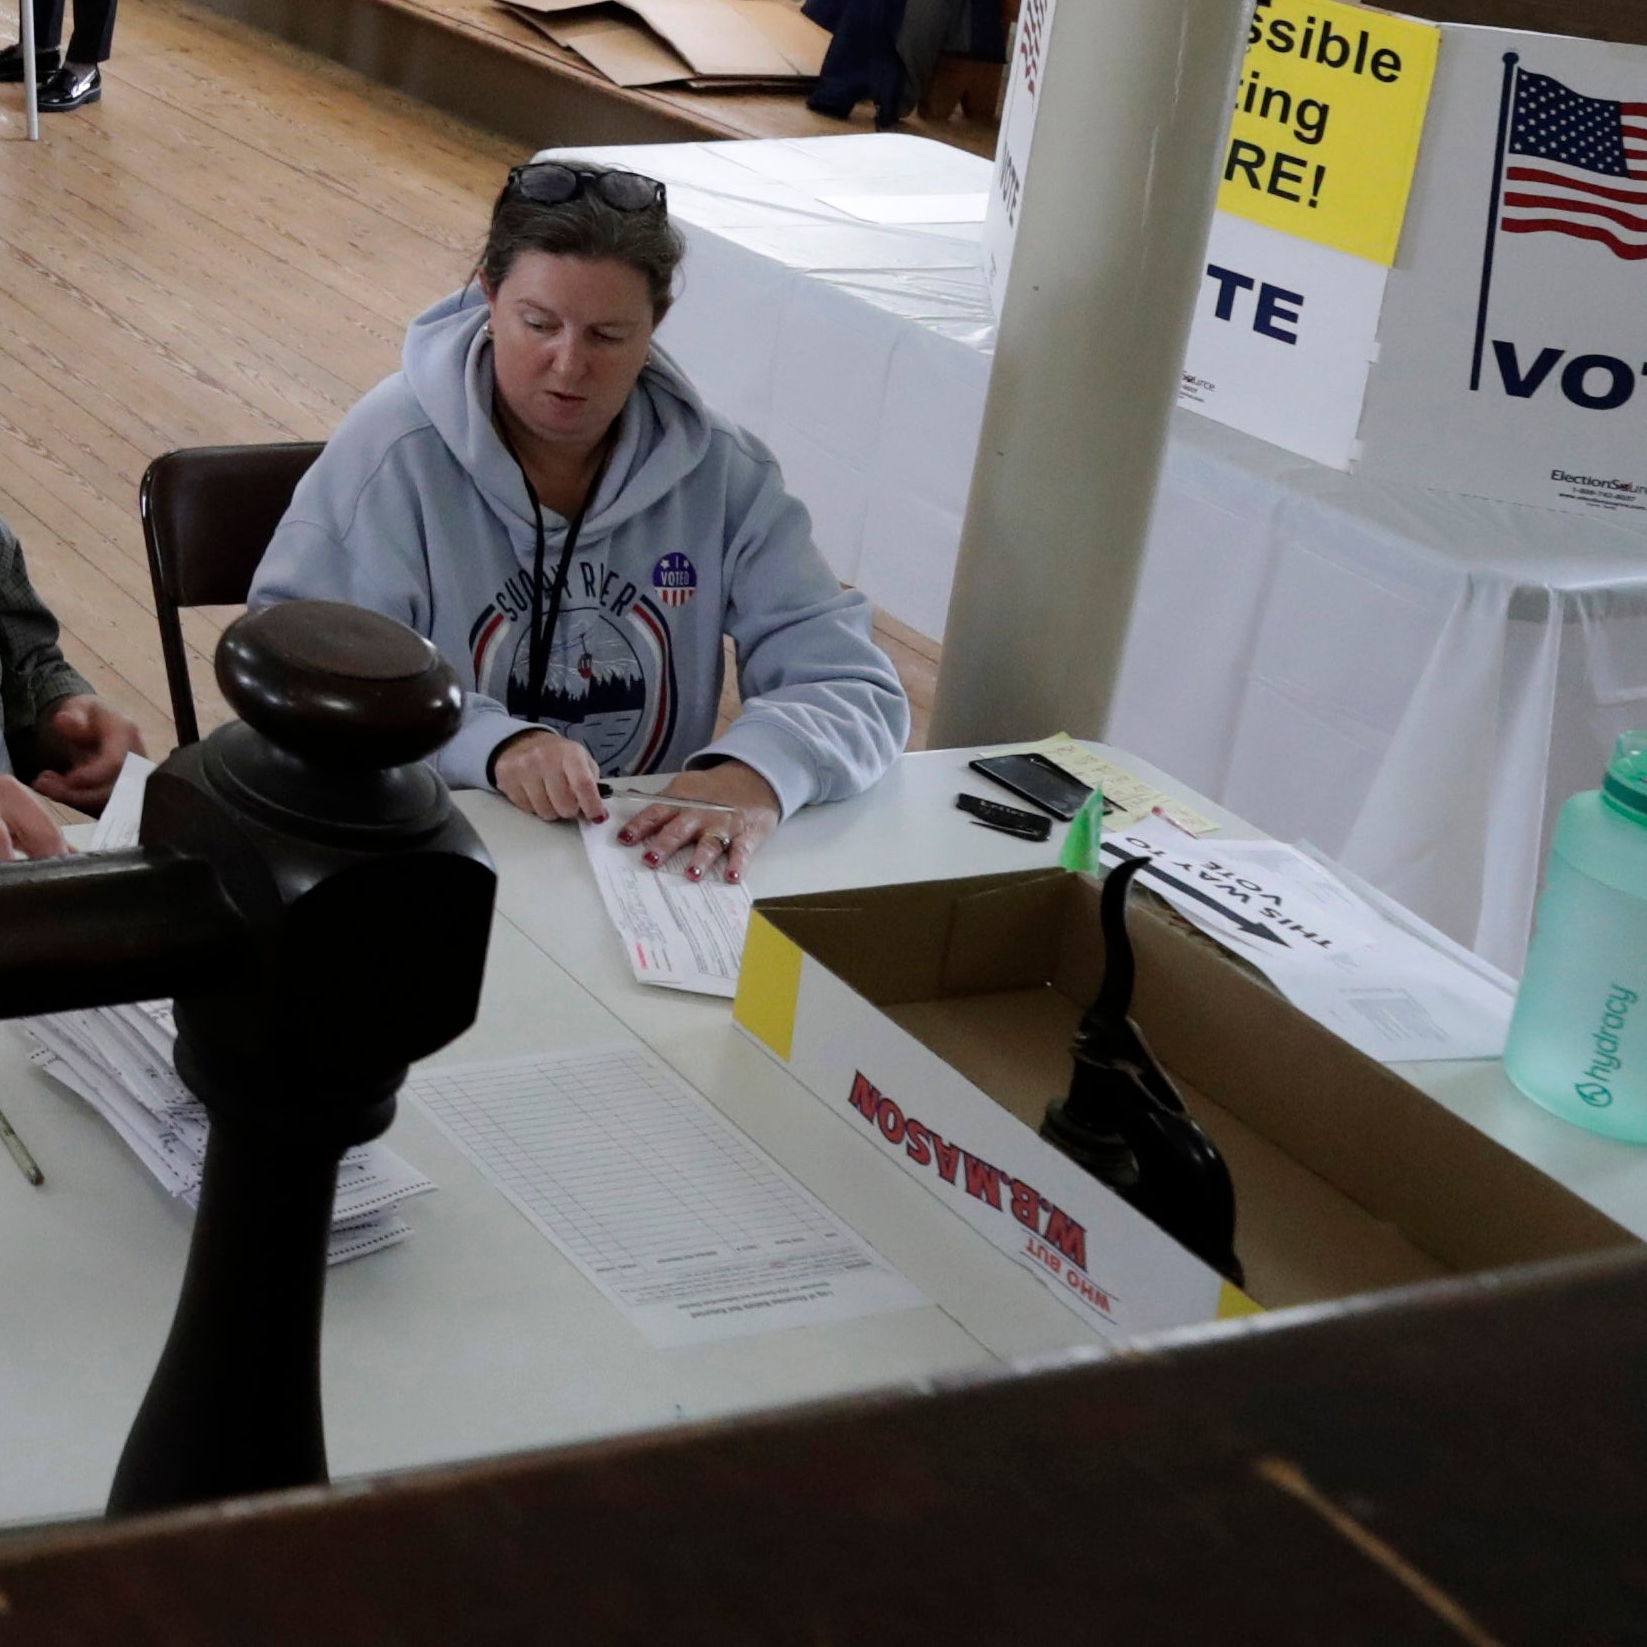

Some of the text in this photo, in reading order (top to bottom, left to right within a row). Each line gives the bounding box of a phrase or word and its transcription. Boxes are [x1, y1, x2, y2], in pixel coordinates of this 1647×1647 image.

[1235, 71, 1330, 146] ing
[1224, 138, 1327, 209] RE!
[1492, 339, 1647, 411] VO
[660, 570, 690, 587] VOTED
[1125, 837, 1333, 950] THIS WAY TO
[1199, 861, 1283, 907] VOTE
[1583, 983, 1638, 1083] hydracy
[1025, 1239, 1111, 1314] WHO BUT
